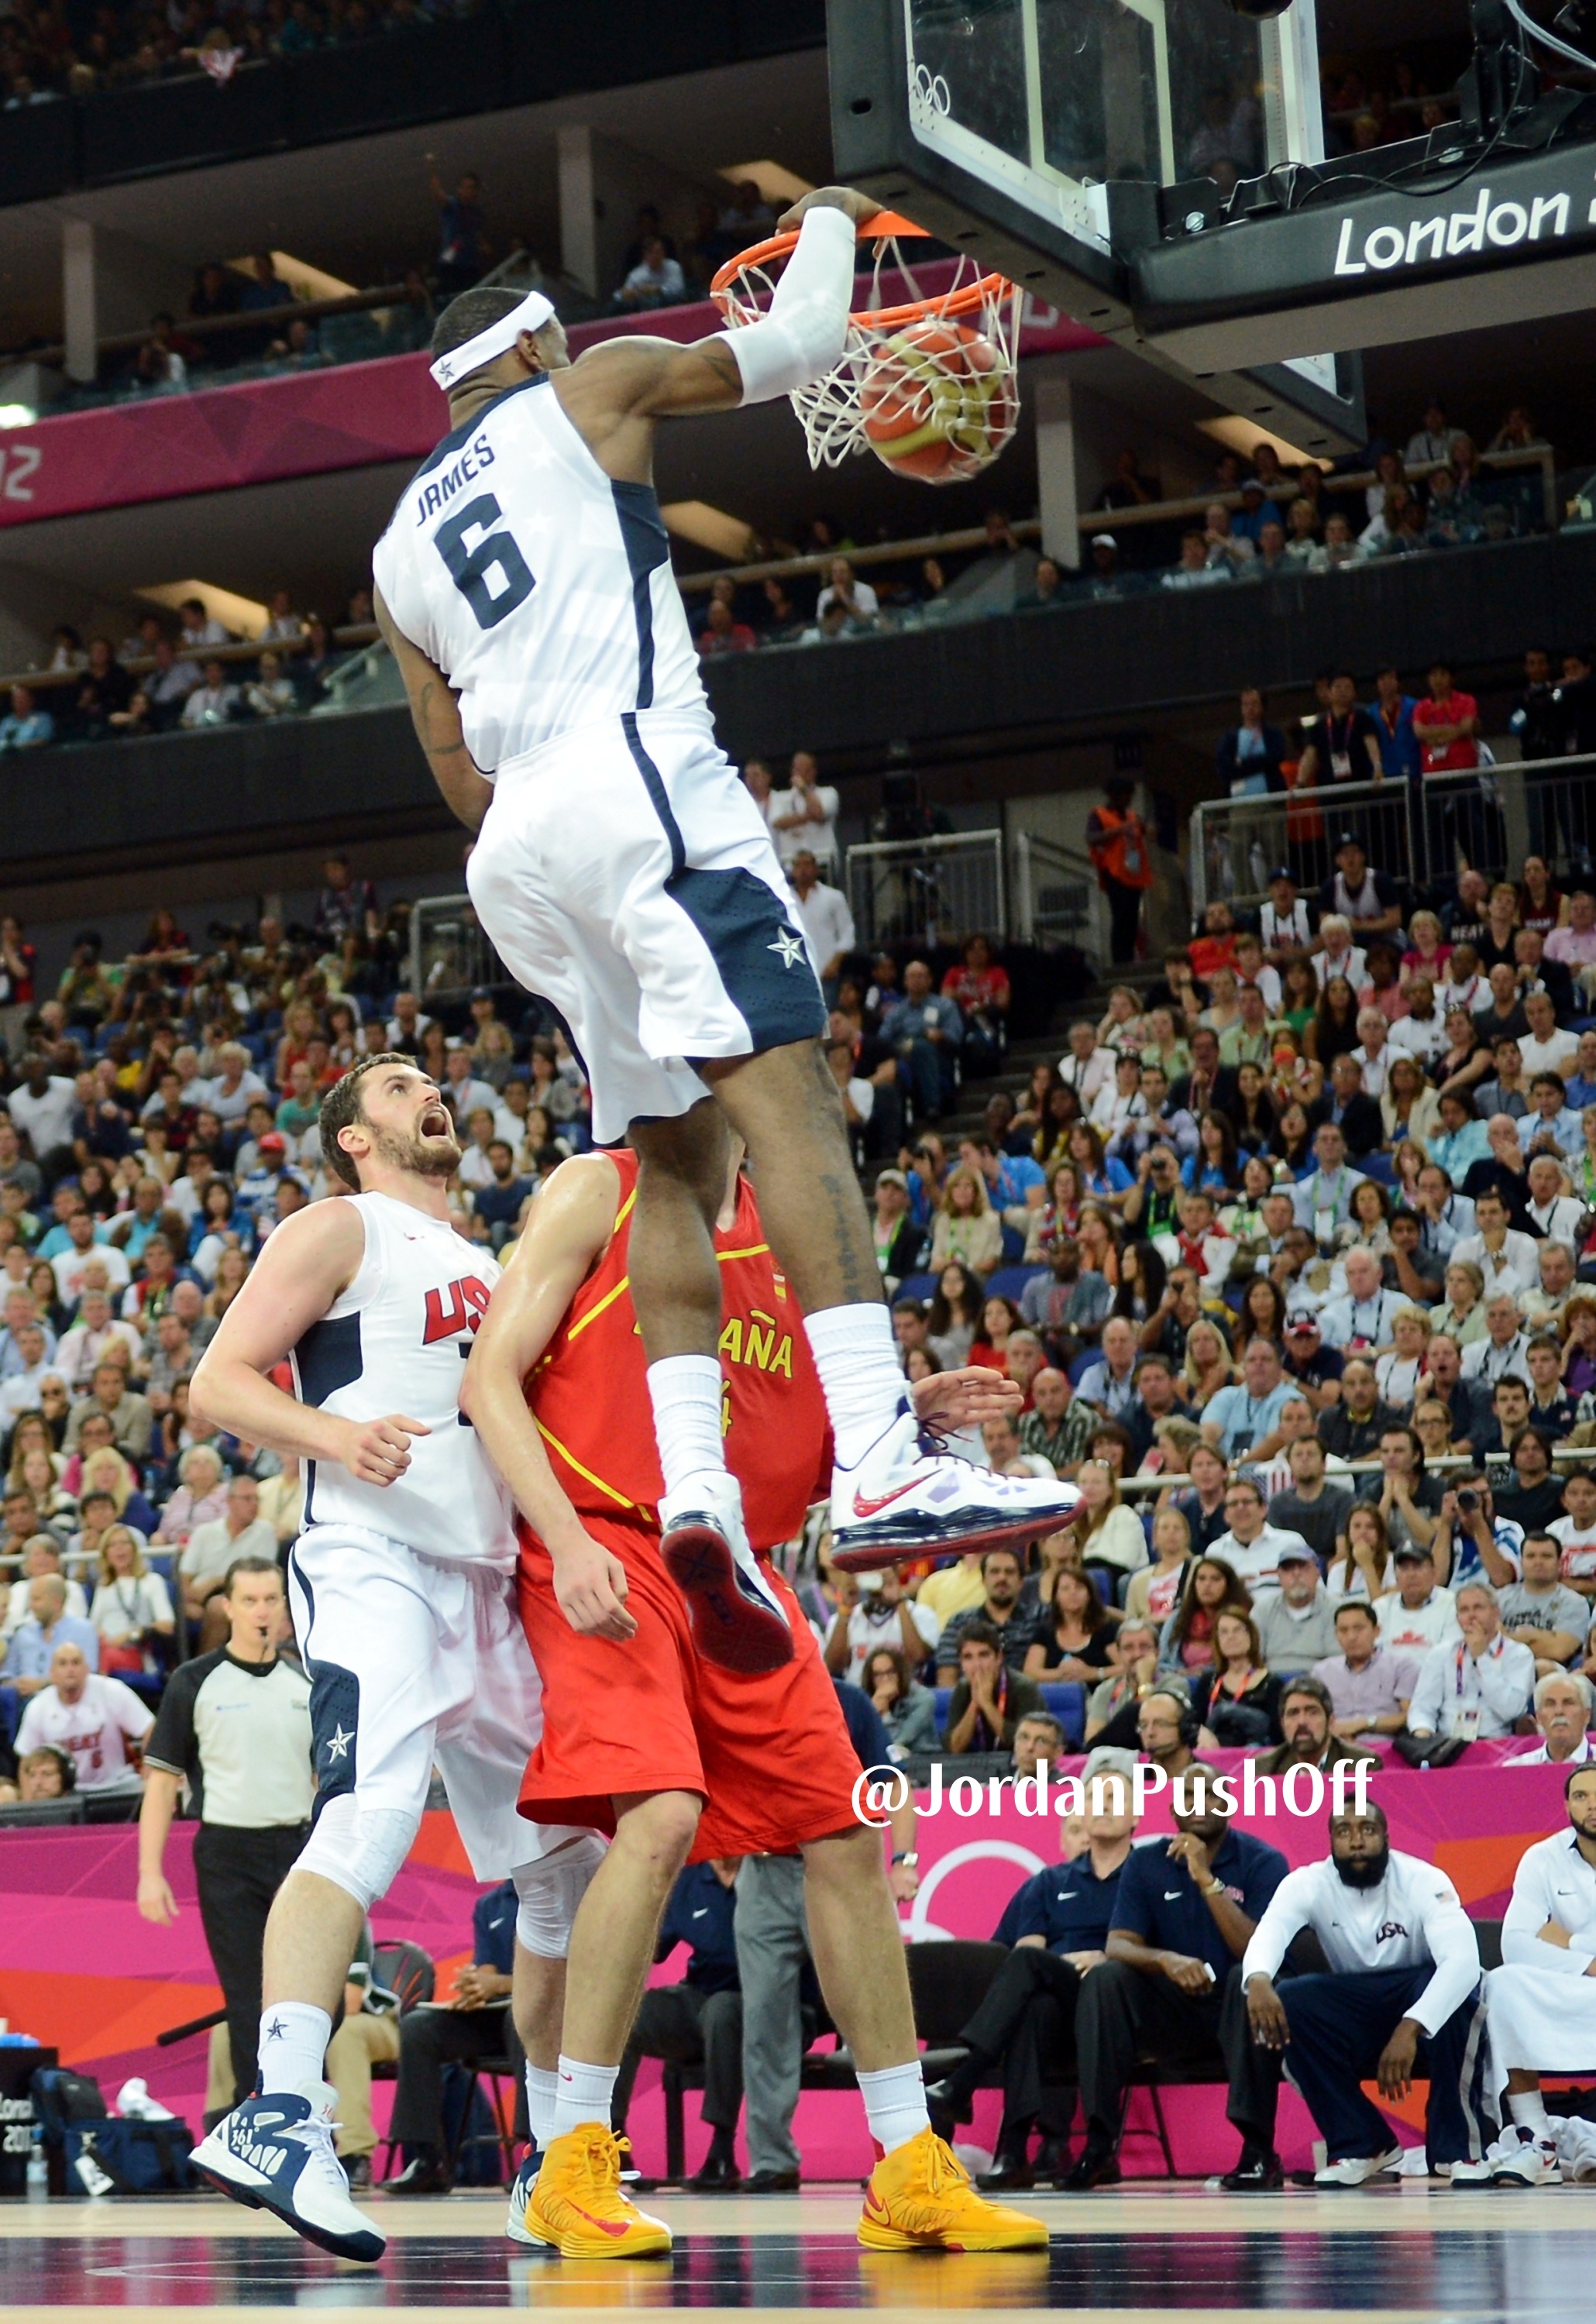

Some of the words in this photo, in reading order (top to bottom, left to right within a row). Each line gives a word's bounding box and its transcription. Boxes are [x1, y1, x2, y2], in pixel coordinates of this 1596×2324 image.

[1334, 188, 1570, 275] London
[417, 434, 495, 527] JAMES
[433, 492, 537, 631] 6
[1376, 1922, 1409, 1944] USA
